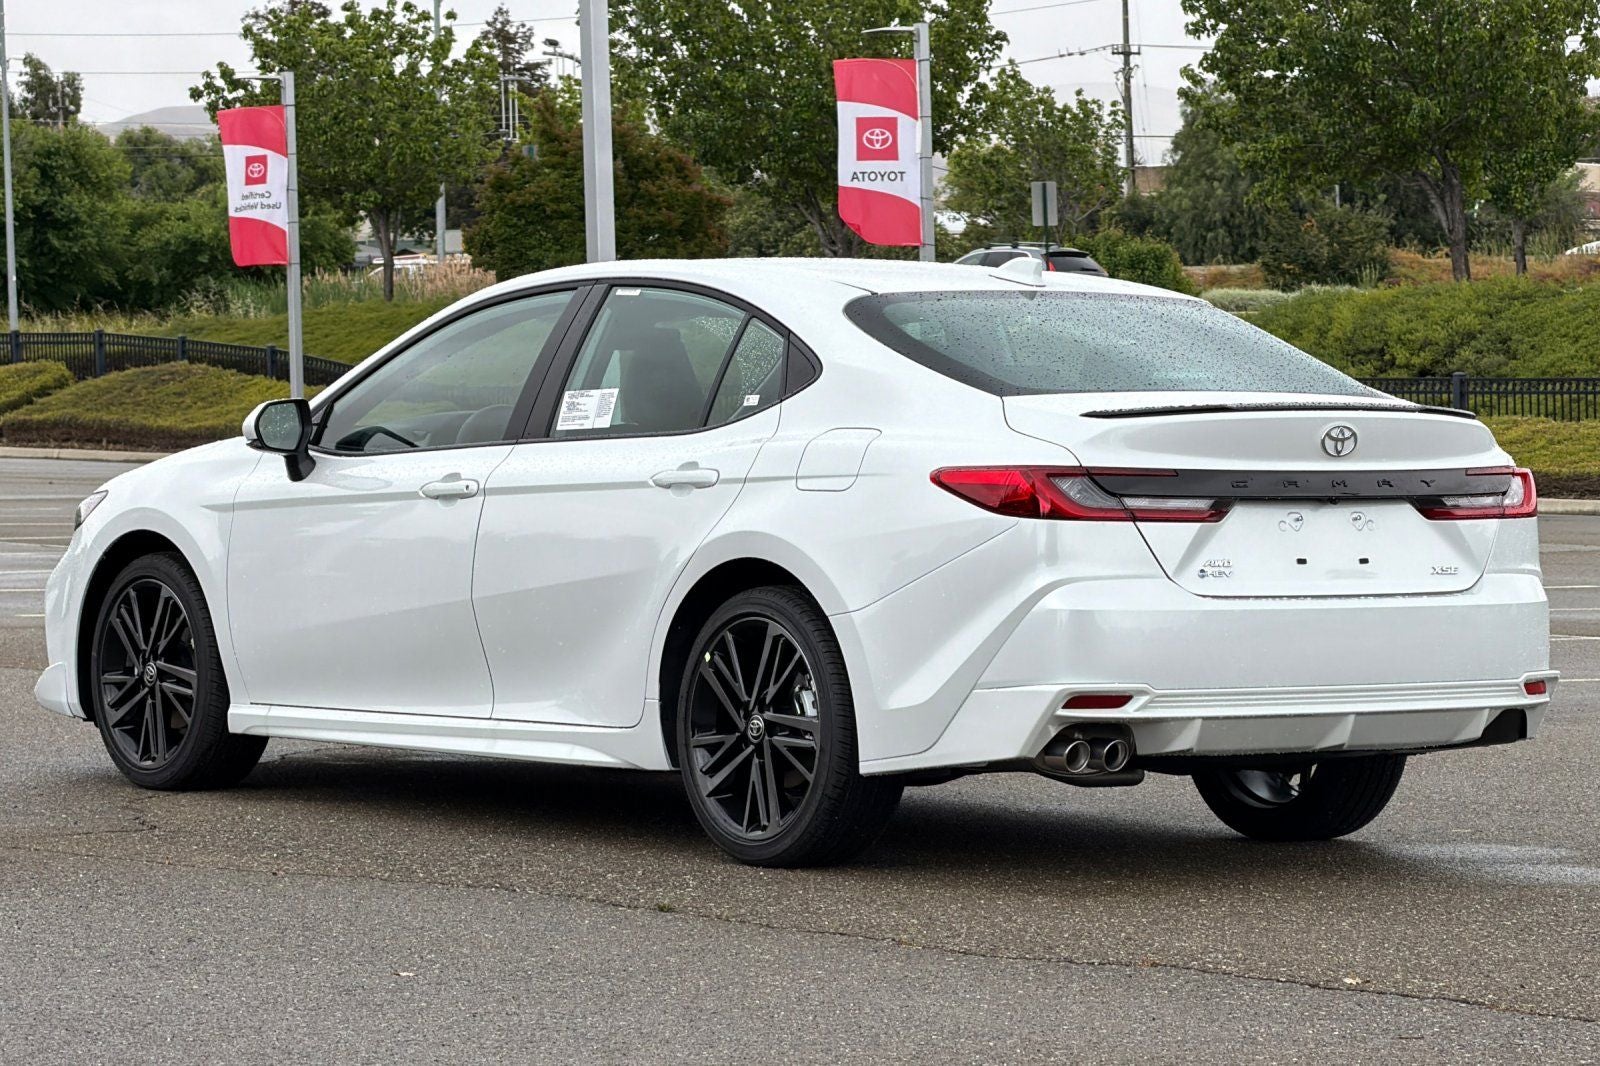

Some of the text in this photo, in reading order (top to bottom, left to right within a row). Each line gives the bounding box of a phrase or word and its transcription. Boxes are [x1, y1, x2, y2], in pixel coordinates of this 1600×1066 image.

[1231, 479, 1436, 488] CAMRY
[1203, 559, 1232, 568] AWD
[1206, 570, 1232, 578] HEV
[1430, 565, 1459, 575] XSE
